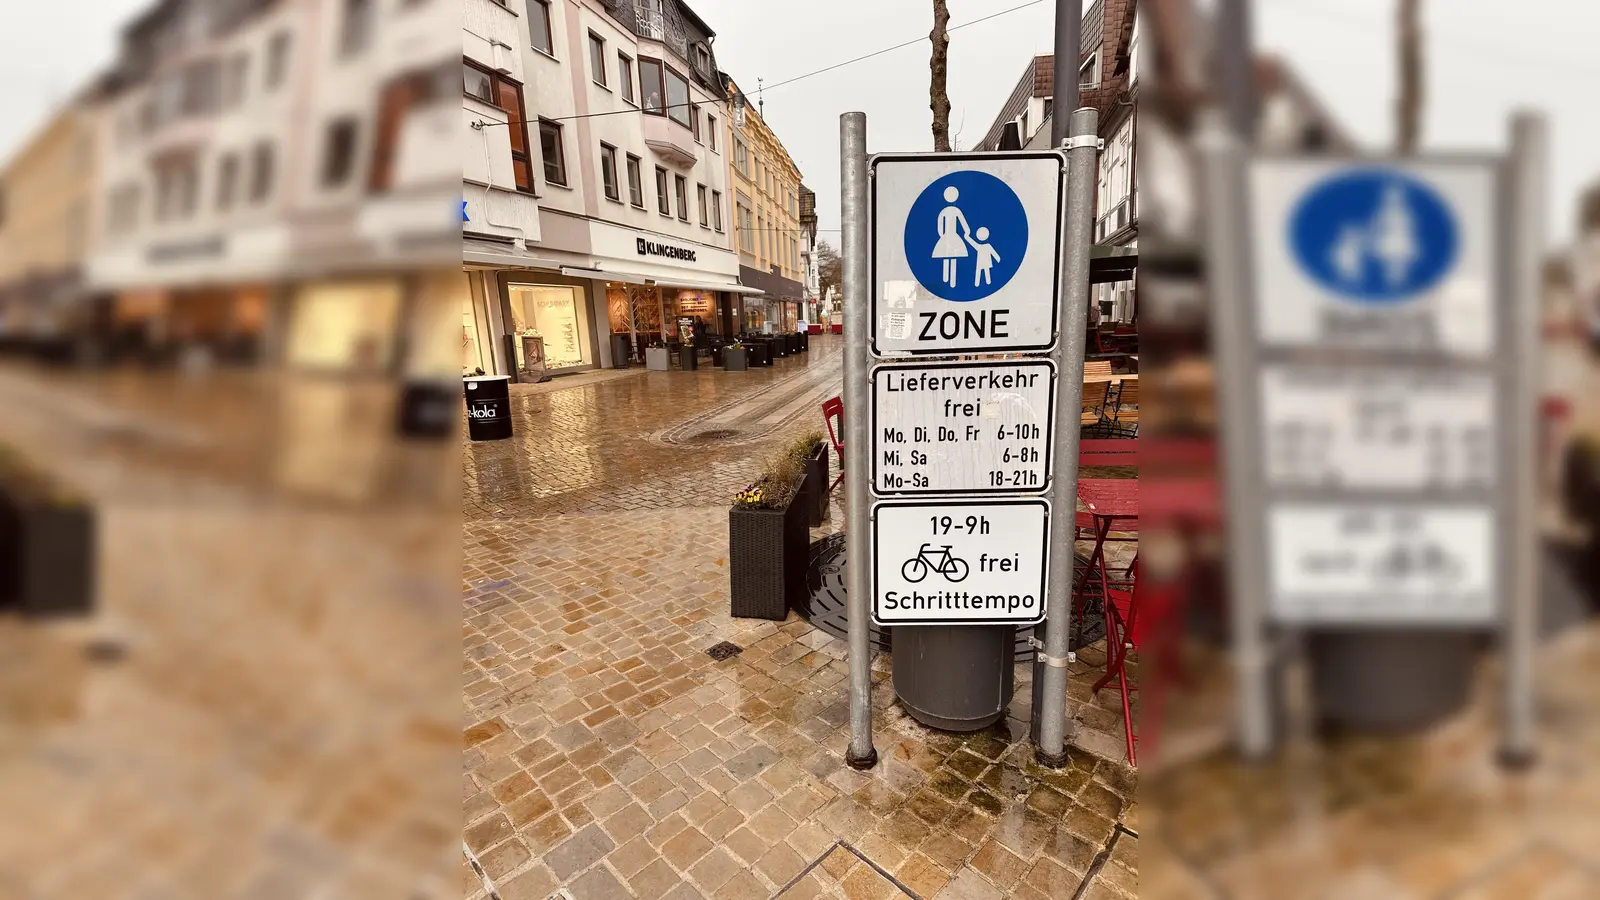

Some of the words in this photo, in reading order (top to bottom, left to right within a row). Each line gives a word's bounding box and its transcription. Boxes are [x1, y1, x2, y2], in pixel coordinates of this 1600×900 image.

[646, 241, 696, 262] KLINGENBERG
[919, 310, 1009, 340] ZONE
[886, 369, 1040, 392] Lieferverkehr
[945, 398, 980, 417] frei
[885, 428, 906, 443] Mo,
[915, 427, 930, 443] Di,
[939, 427, 958, 442] Do,
[966, 426, 980, 440] Fr
[998, 424, 1039, 440] 6-10h
[884, 451, 902, 466] Mi,
[911, 450, 926, 465] Sa
[1003, 447, 1038, 463] 6-8h
[885, 473, 928, 488] Mo-Sa
[989, 470, 1036, 486] 18-21h
[931, 516, 989, 534] 19-9h
[980, 553, 1018, 571] frei
[885, 591, 1034, 613] Schritttempo
